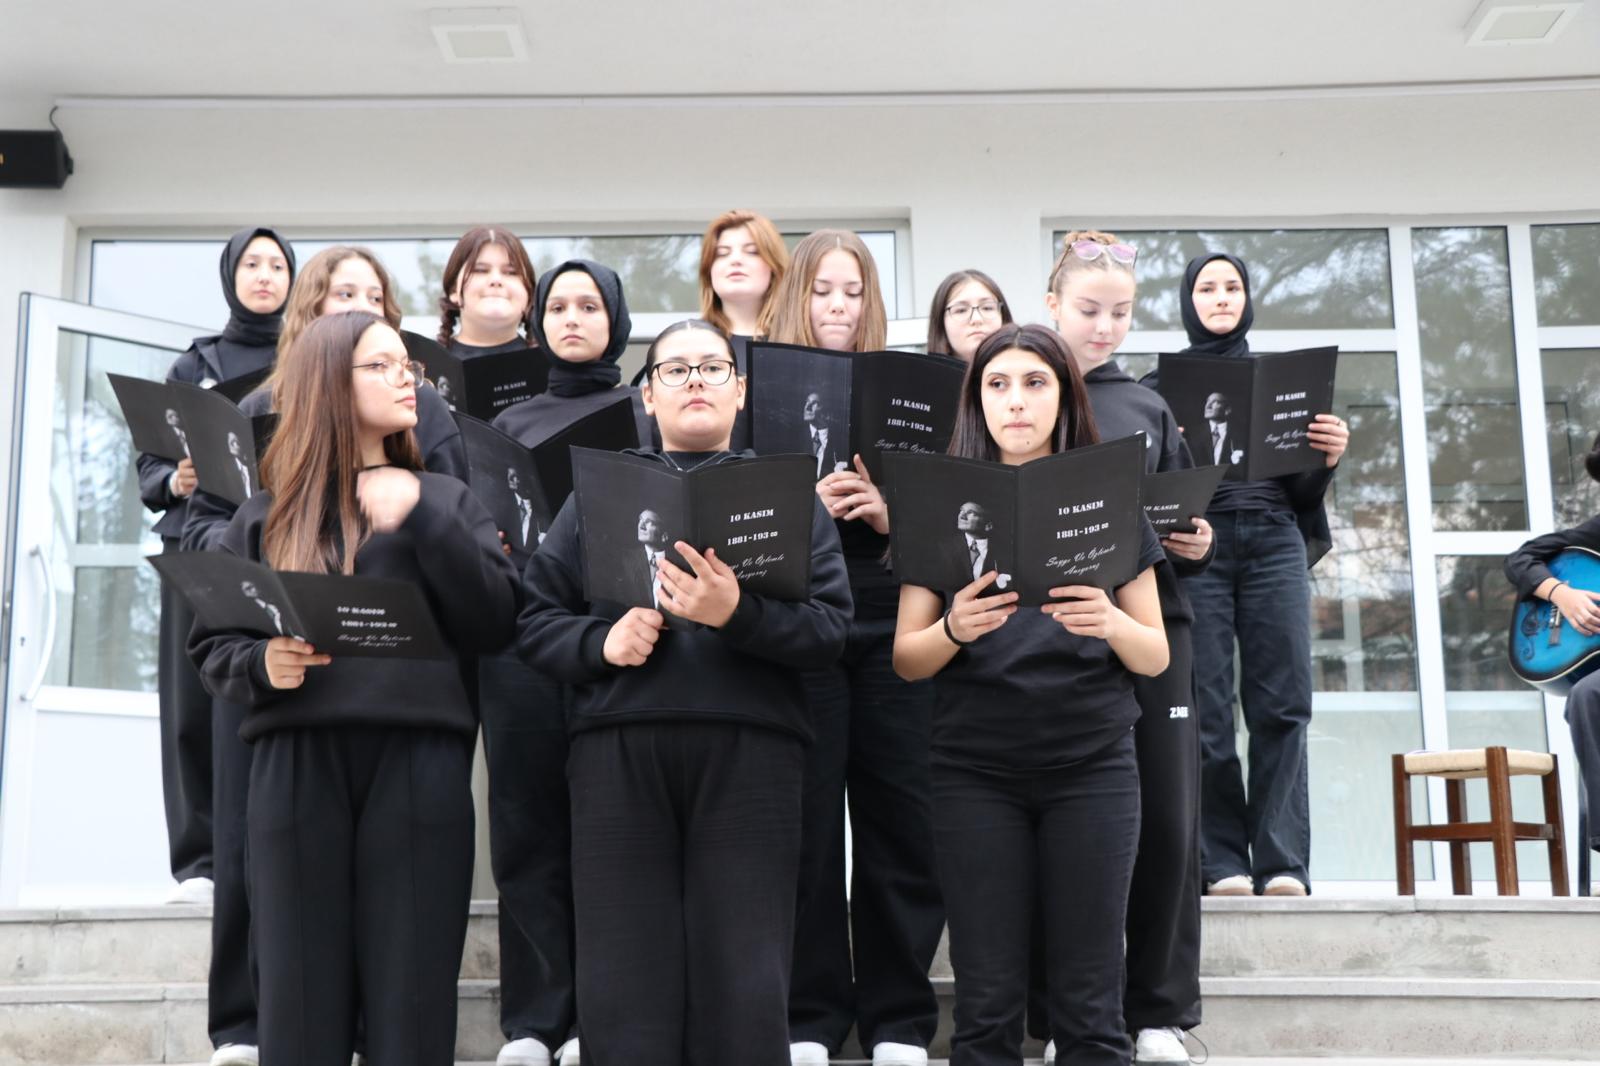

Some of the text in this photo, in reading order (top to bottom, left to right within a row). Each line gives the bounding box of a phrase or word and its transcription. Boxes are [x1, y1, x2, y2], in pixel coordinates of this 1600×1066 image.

[891, 397, 931, 412] 10 KASIM
[1058, 499, 1105, 516] 10 KASIM
[730, 508, 774, 523] 10 KASIM
